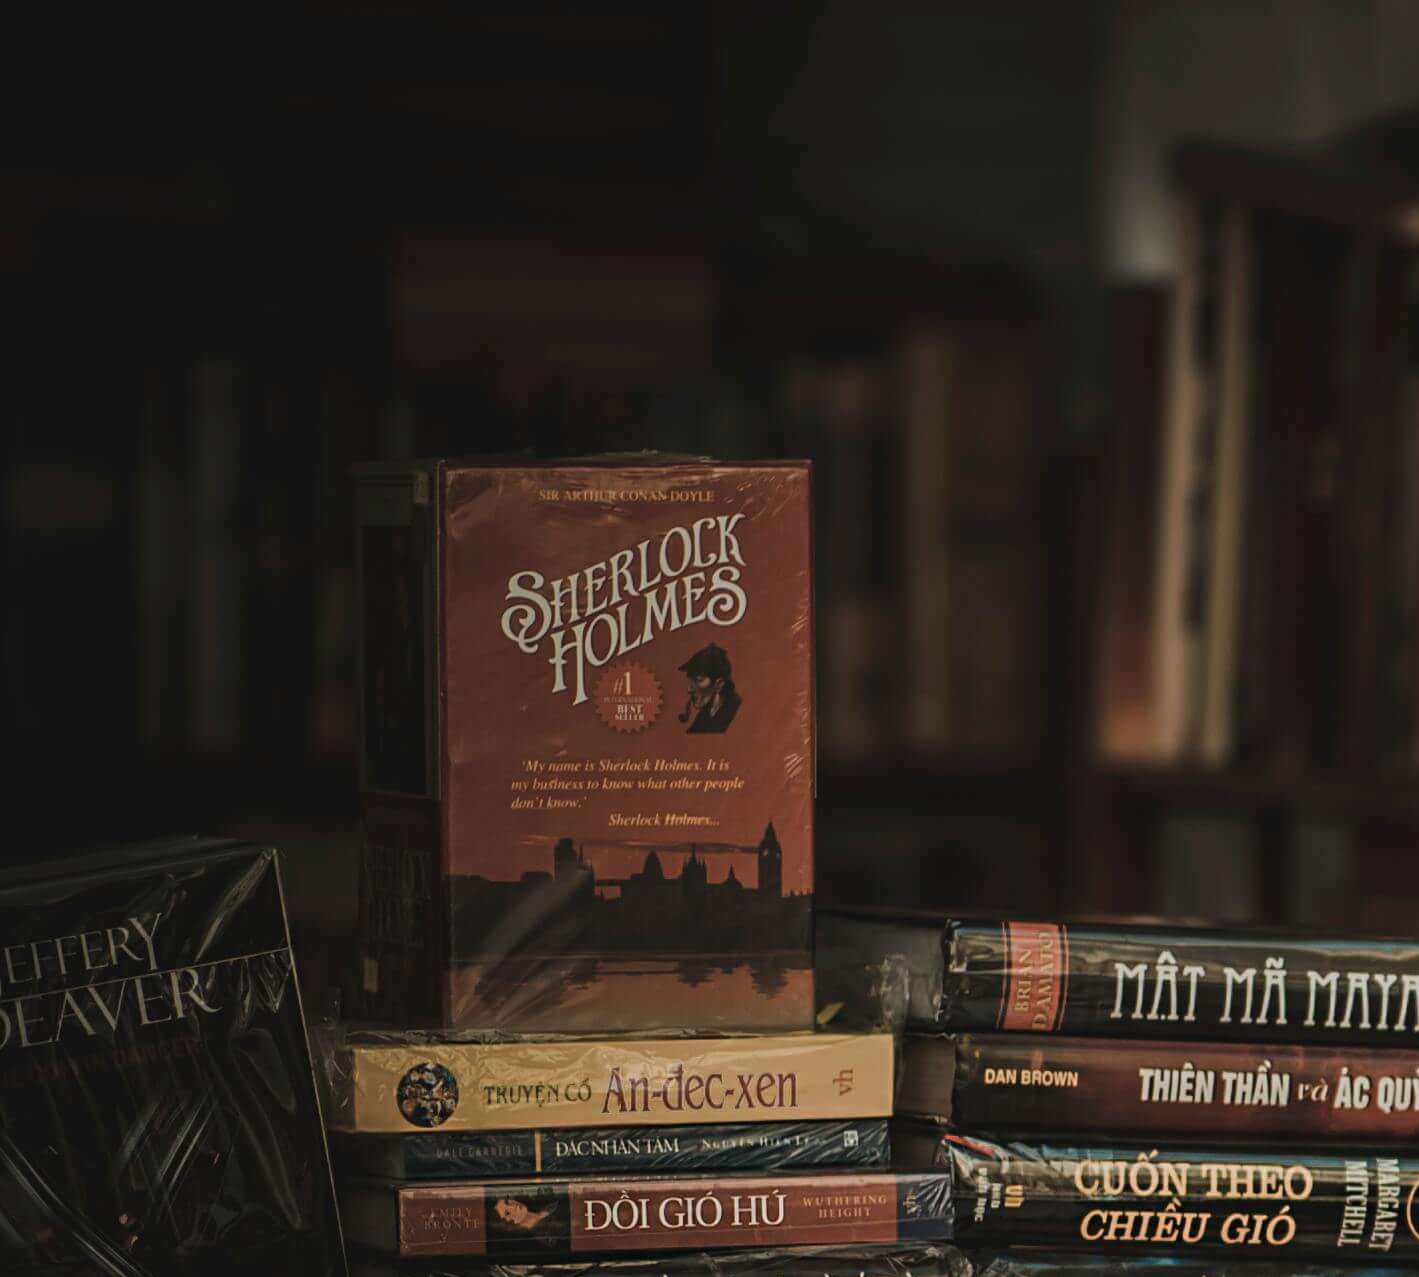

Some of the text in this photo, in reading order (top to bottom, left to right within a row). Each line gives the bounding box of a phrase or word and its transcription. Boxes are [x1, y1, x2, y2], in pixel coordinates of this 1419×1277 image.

[671, 489, 715, 501] DOYLE
[501, 512, 747, 655] SHERLOCK
[548, 566, 748, 707] HOLMES
[612, 671, 633, 696] #1
[532, 776, 745, 793] business know what other people
[598, 759, 650, 772] Sherlock
[608, 813, 661, 827] Sherlock
[0, 912, 163, 985] EFFERY
[1109, 950, 1206, 1022] MẬT
[1218, 956, 1288, 1025] MÃ
[483, 1083, 560, 1109] TRUYỆN
[983, 1059, 1329, 1107] DAN BROWN THIÊN THẦN và
[1072, 1148, 1315, 1201] CUỐN THEO
[584, 1188, 788, 1231] ĐỒI GIÓ HÚ
[818, 1206, 872, 1219] HEIGHT
[1079, 1198, 1298, 1247] CHIỀU GIÓ
[1336, 1159, 1368, 1248] MITCHELL
[1368, 1157, 1400, 1253] MARGARET
